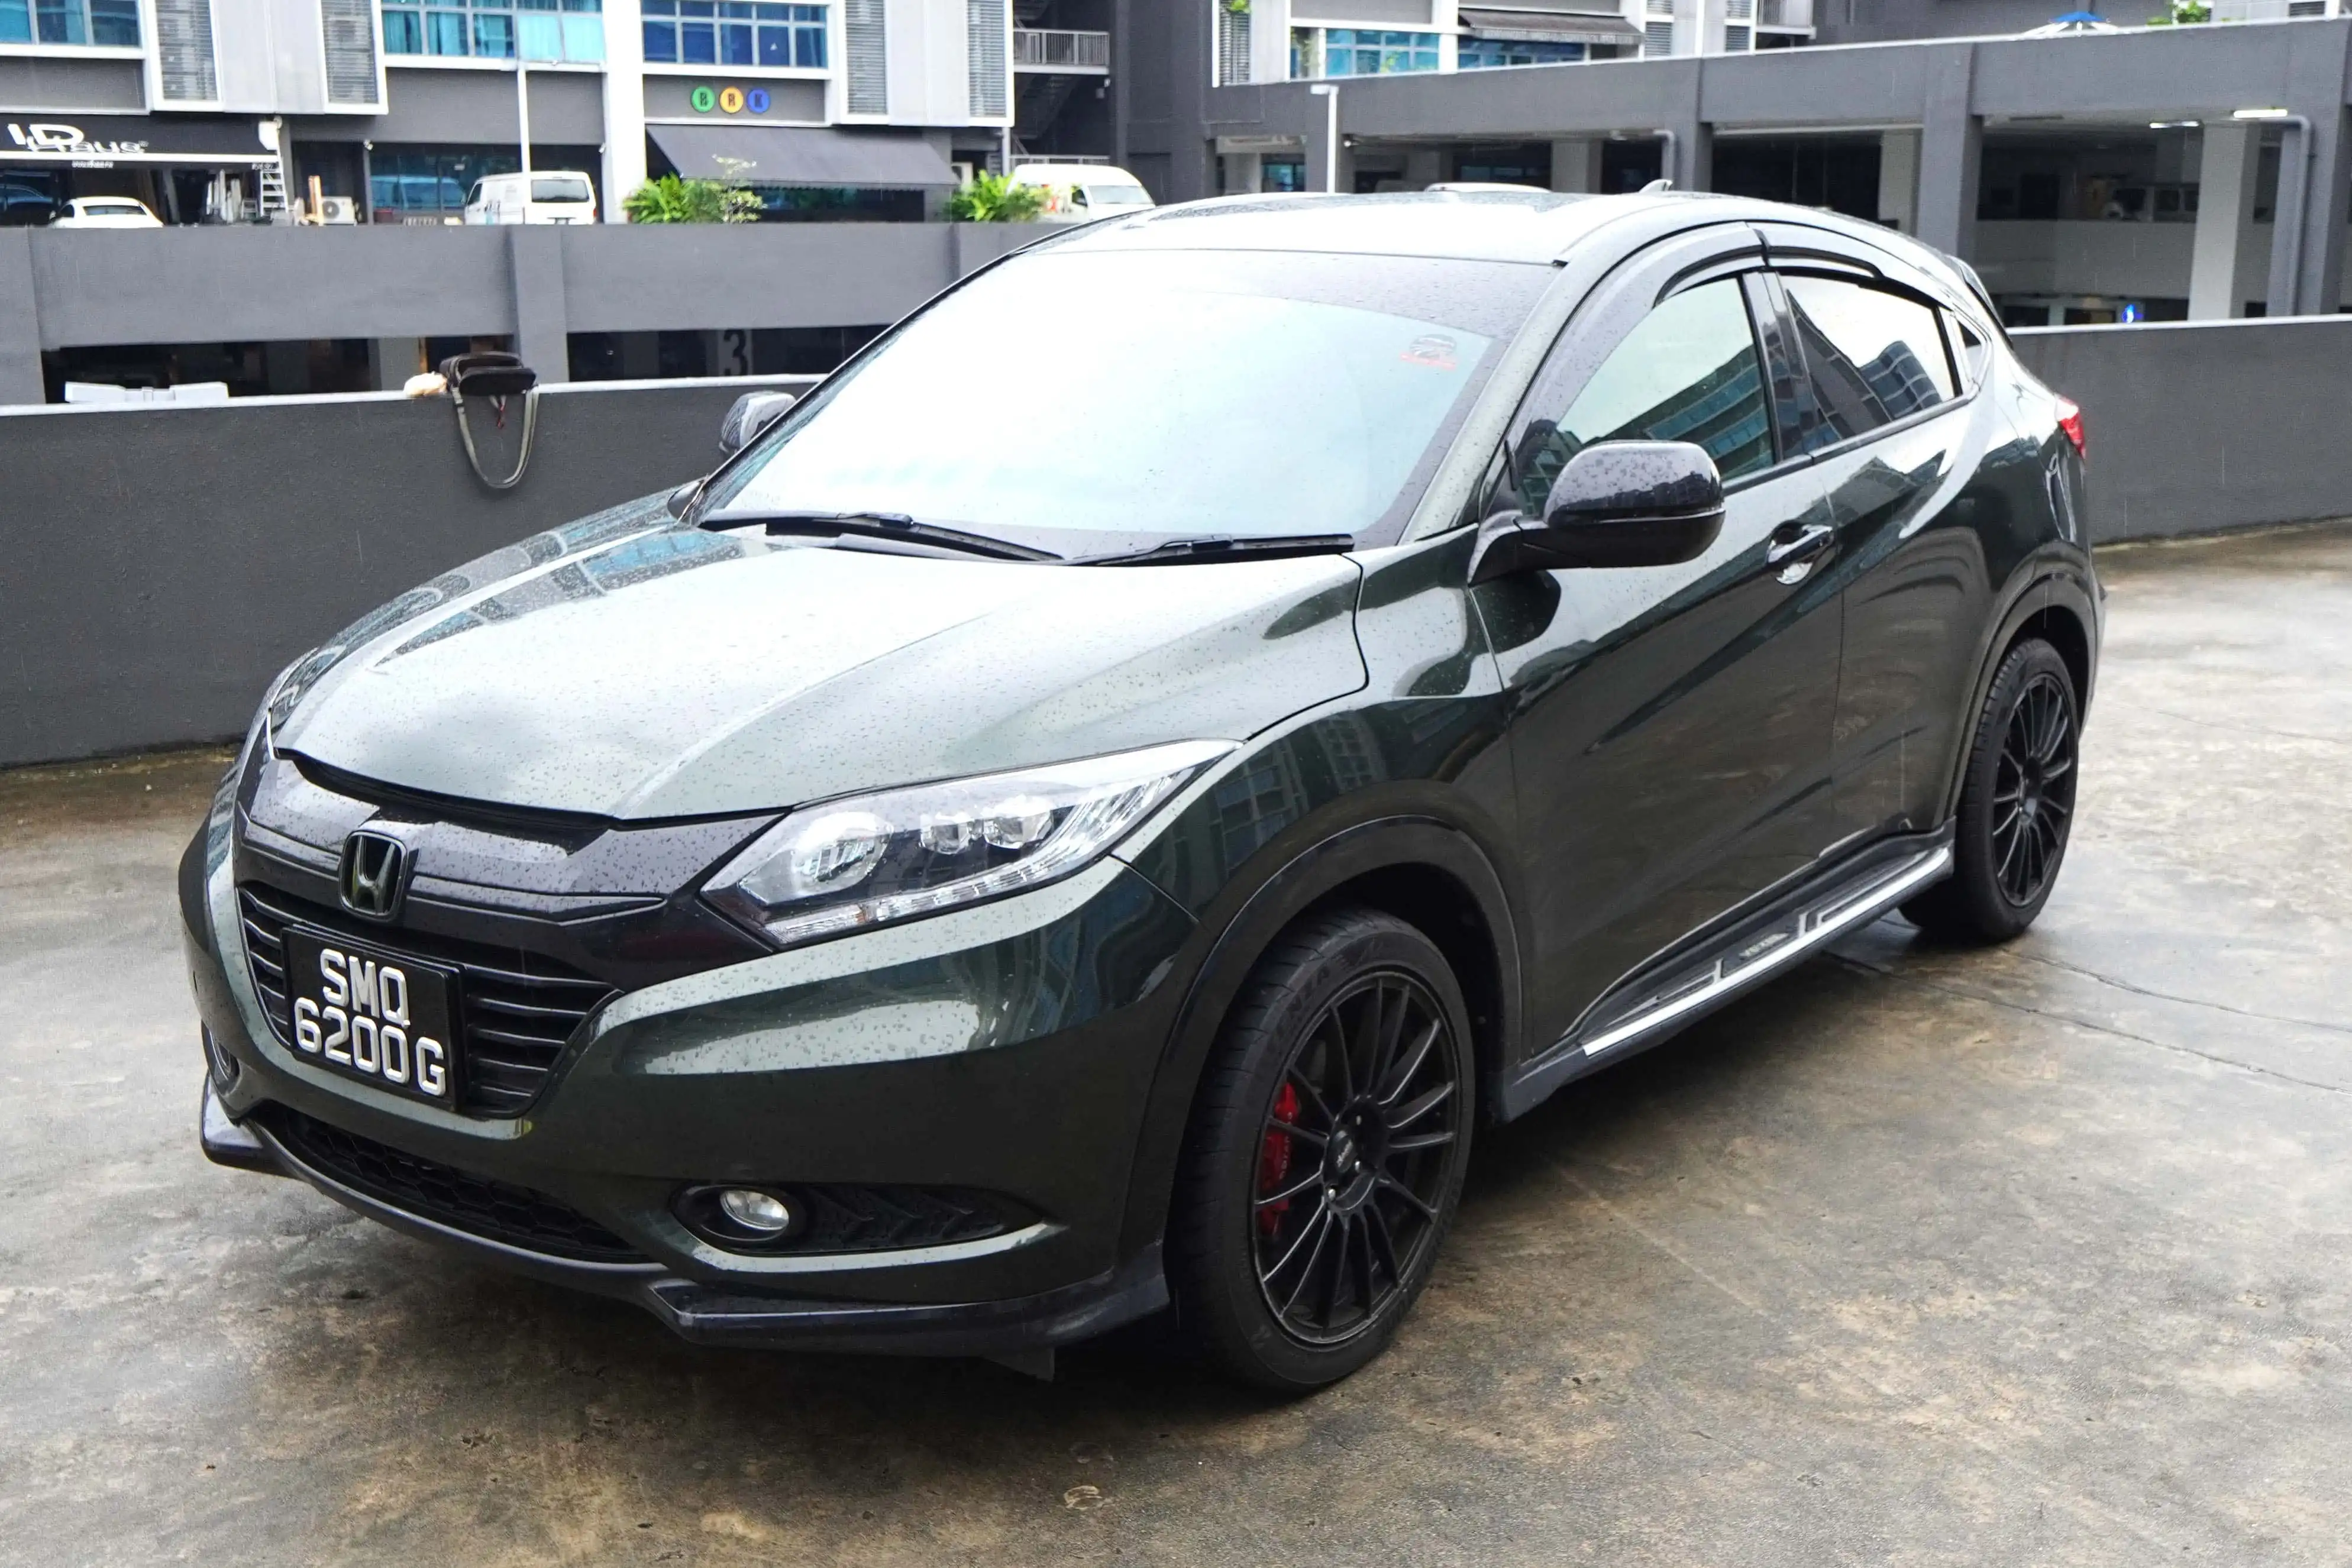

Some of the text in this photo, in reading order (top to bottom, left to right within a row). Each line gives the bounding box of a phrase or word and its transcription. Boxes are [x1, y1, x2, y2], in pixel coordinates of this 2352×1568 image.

[723, 329, 748, 376] 3
[320, 948, 411, 1029] SMQ
[295, 997, 445, 1096] 6200 G
